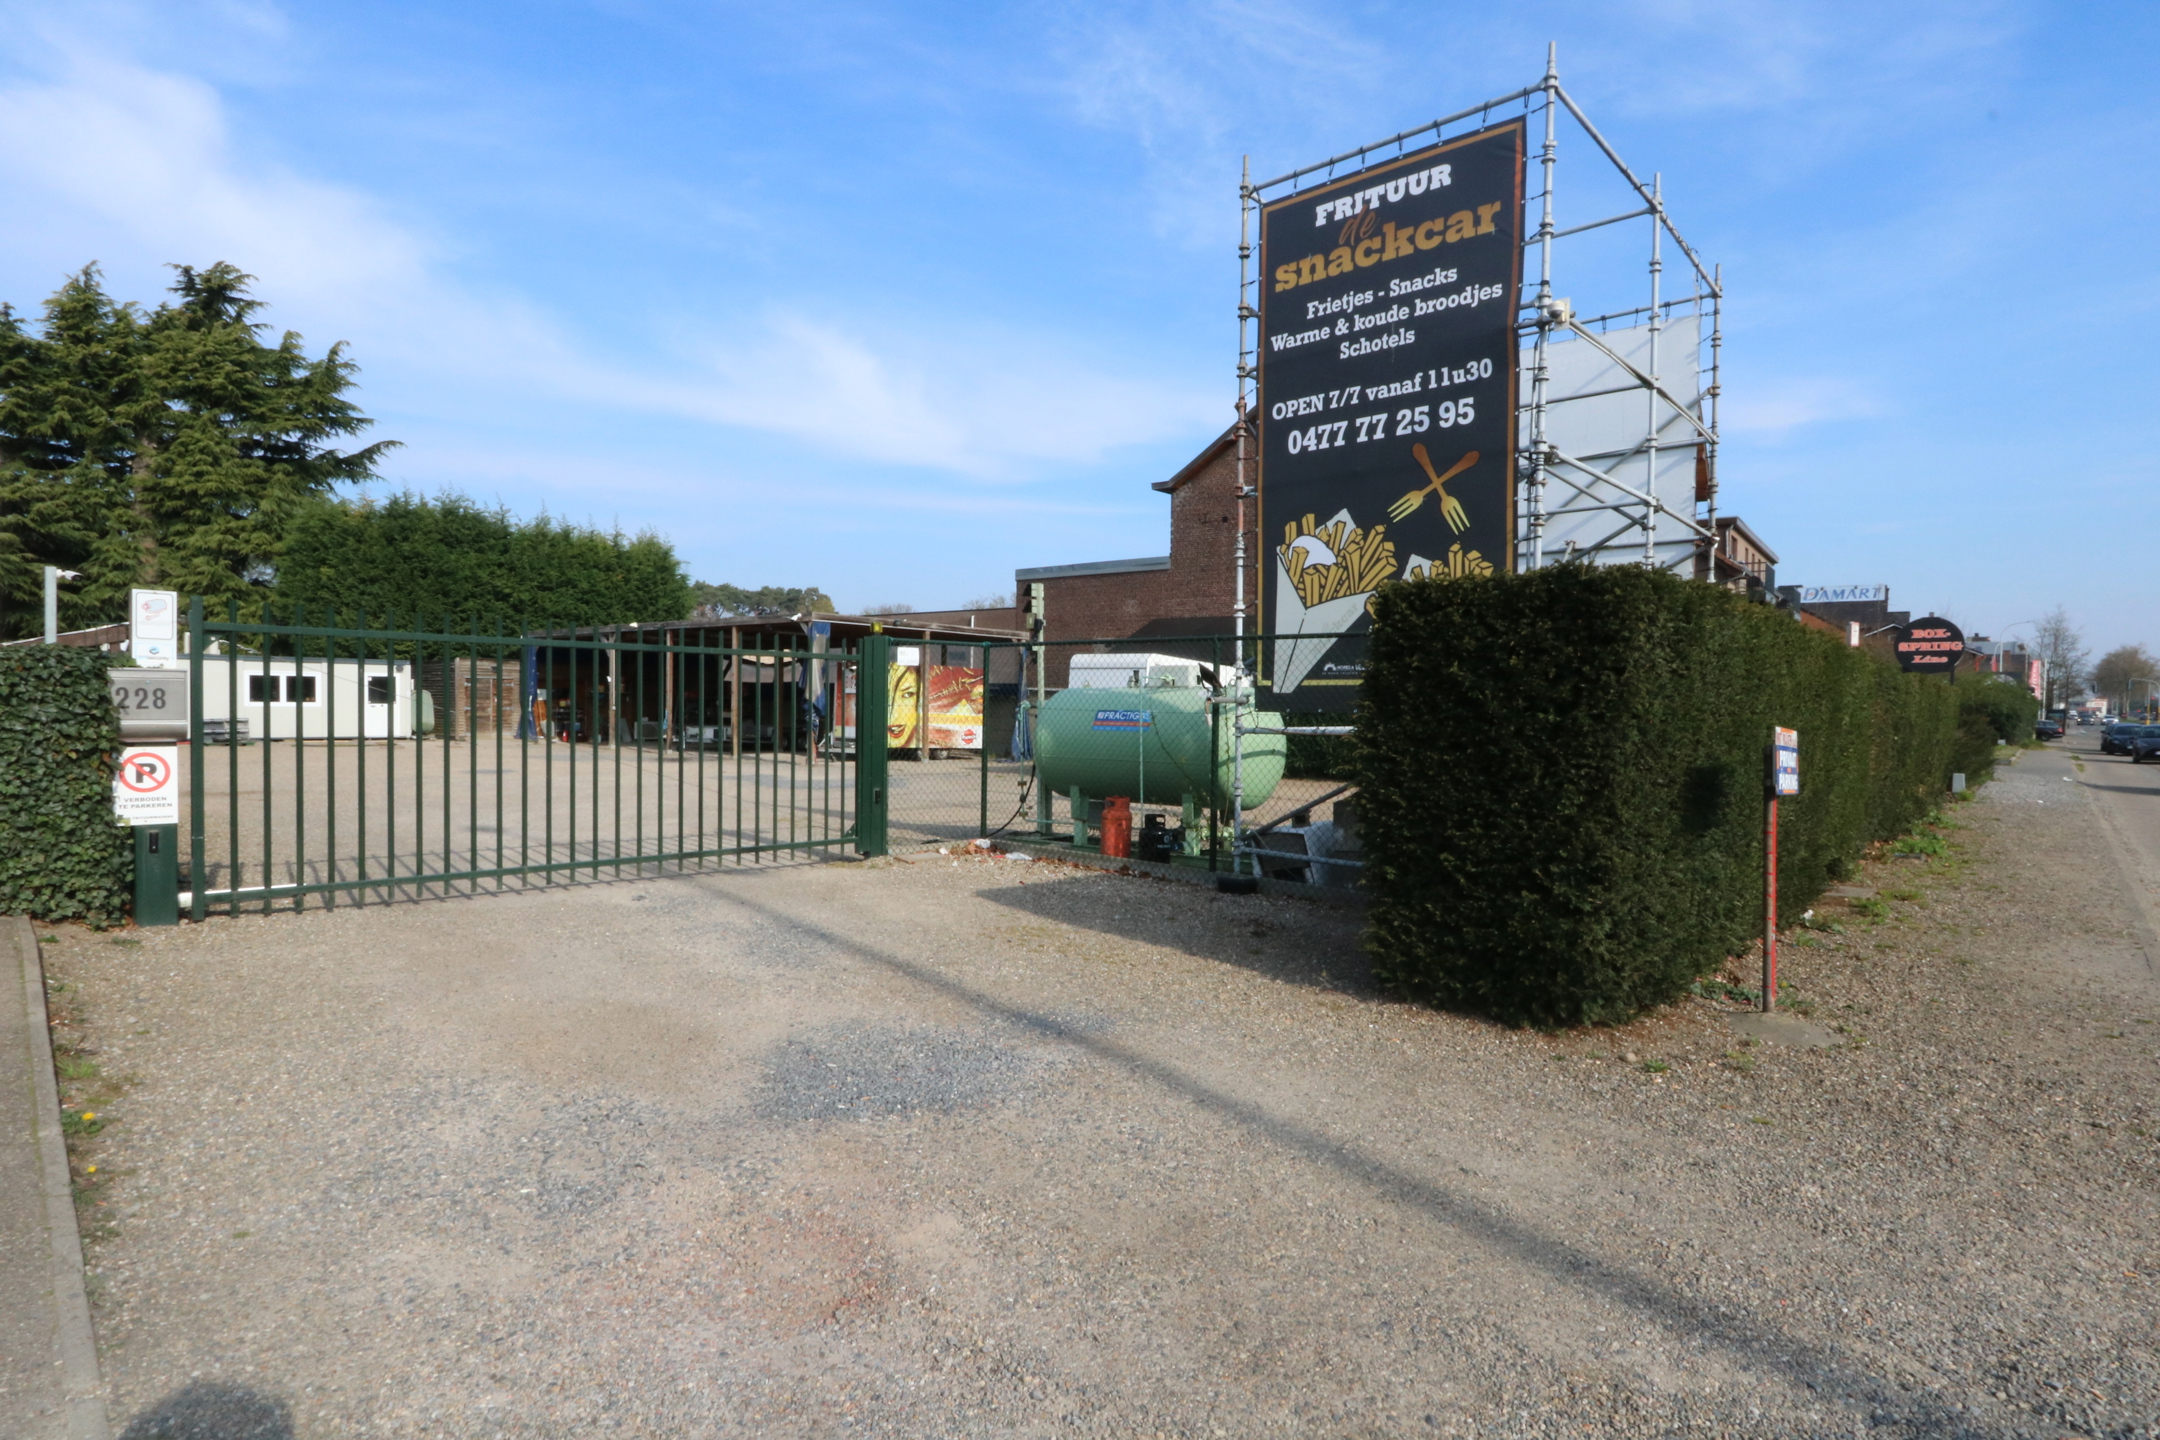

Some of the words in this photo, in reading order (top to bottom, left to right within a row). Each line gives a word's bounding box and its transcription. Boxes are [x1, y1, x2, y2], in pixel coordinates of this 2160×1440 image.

[1315, 163, 1452, 228] FRITUUR
[1274, 201, 1502, 293] snackcar
[1339, 203, 1381, 246] de
[1270, 325, 1331, 352] Warme
[1335, 317, 1349, 337] &
[1353, 304, 1410, 332] koude
[1414, 283, 1503, 317] broodjes
[1306, 289, 1374, 320] Frietjes
[1389, 267, 1458, 298] Snacks
[1339, 328, 1416, 360] Schotels
[1272, 393, 1325, 421] OPEN
[1329, 385, 1361, 409] 7/7
[1365, 372, 1424, 402] vanaf
[1428, 358, 1493, 390] 11u30
[1287, 420, 1349, 455] 0477
[1355, 412, 1388, 443] 77
[1395, 404, 1430, 437] 25
[1438, 397, 1475, 429] 95
[1803, 587, 1881, 601] DAMART
[1898, 641, 1964, 652] SPRING
[1911, 628, 1951, 639] BOX-
[115, 687, 167, 710] 228
